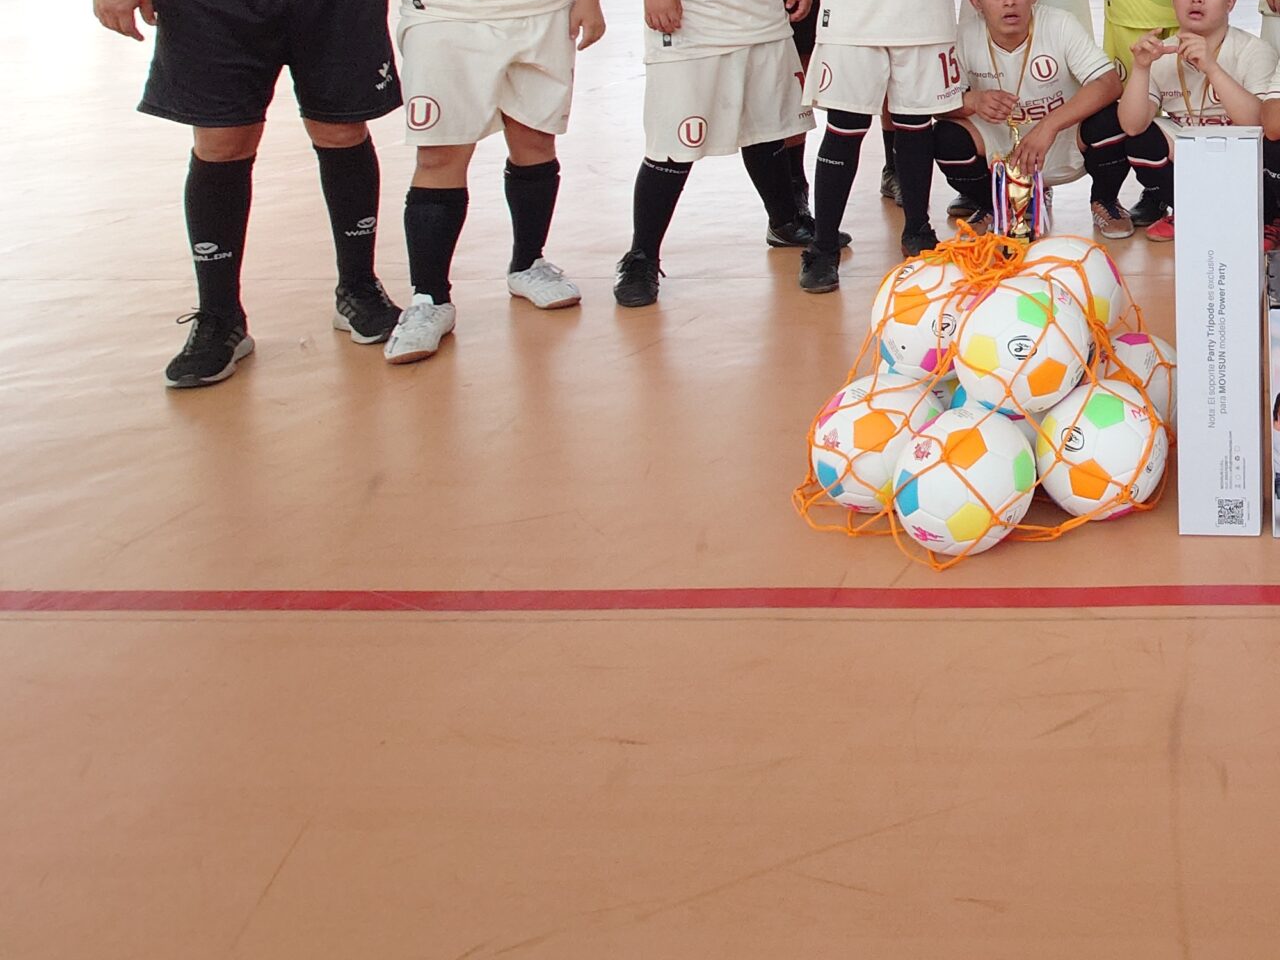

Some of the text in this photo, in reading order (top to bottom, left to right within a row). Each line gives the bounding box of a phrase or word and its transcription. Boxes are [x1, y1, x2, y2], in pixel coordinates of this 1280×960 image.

[938, 46, 960, 89] 15
[1014, 90, 1063, 108] LECTIVO
[1218, 262, 1227, 285] Party
[1208, 290, 1214, 301] es
[1218, 288, 1226, 315] Power
[1218, 317, 1226, 349] modelo
[1207, 339, 1216, 361] Party
[1208, 364, 1216, 395] soporte
[1218, 351, 1226, 393] MOVISUN
